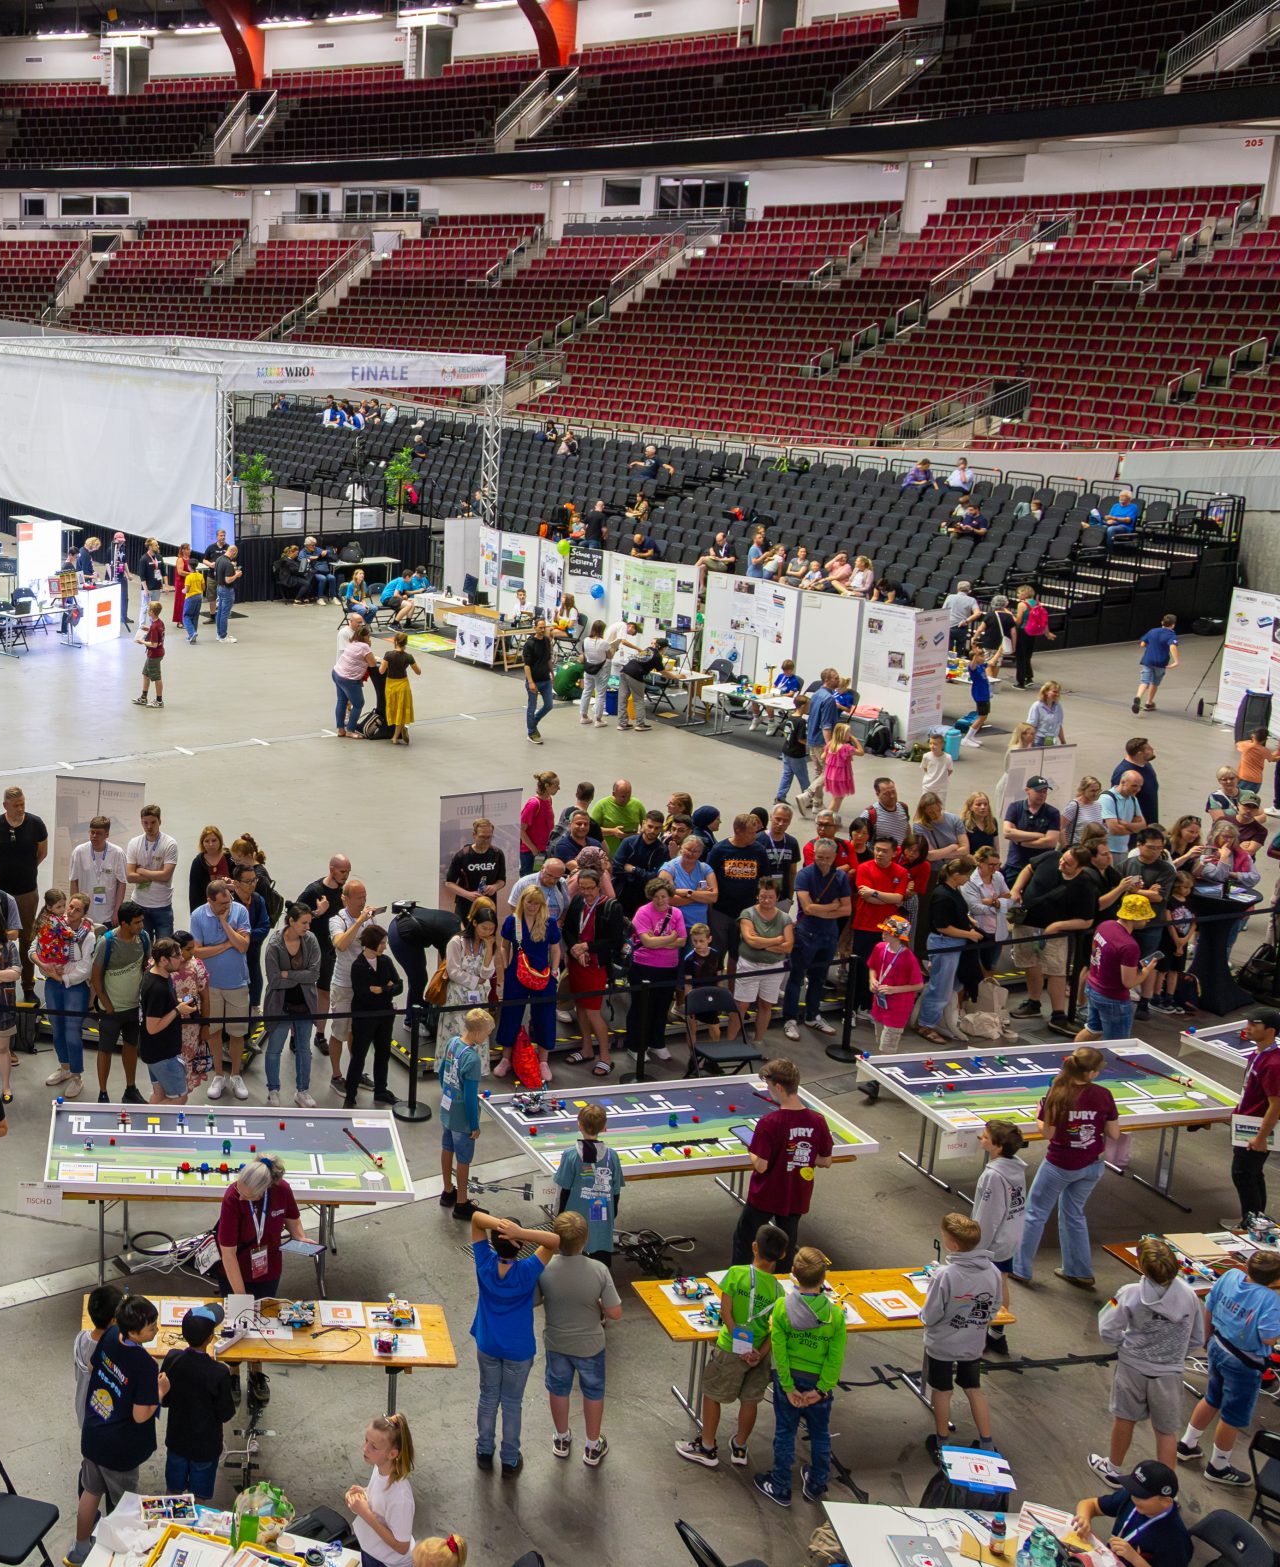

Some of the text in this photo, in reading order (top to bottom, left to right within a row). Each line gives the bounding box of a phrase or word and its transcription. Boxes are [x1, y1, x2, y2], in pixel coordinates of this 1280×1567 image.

[1245, 139, 1264, 147] 205
[285, 366, 310, 377] WRO
[351, 365, 409, 381] FINALE
[468, 862, 496, 871] OAKLEY
[1069, 1110, 1098, 1122] JURY
[789, 1127, 814, 1140] JURY
[26, 1197, 46, 1205] TISCH
[799, 1338, 818, 1349] 2025
